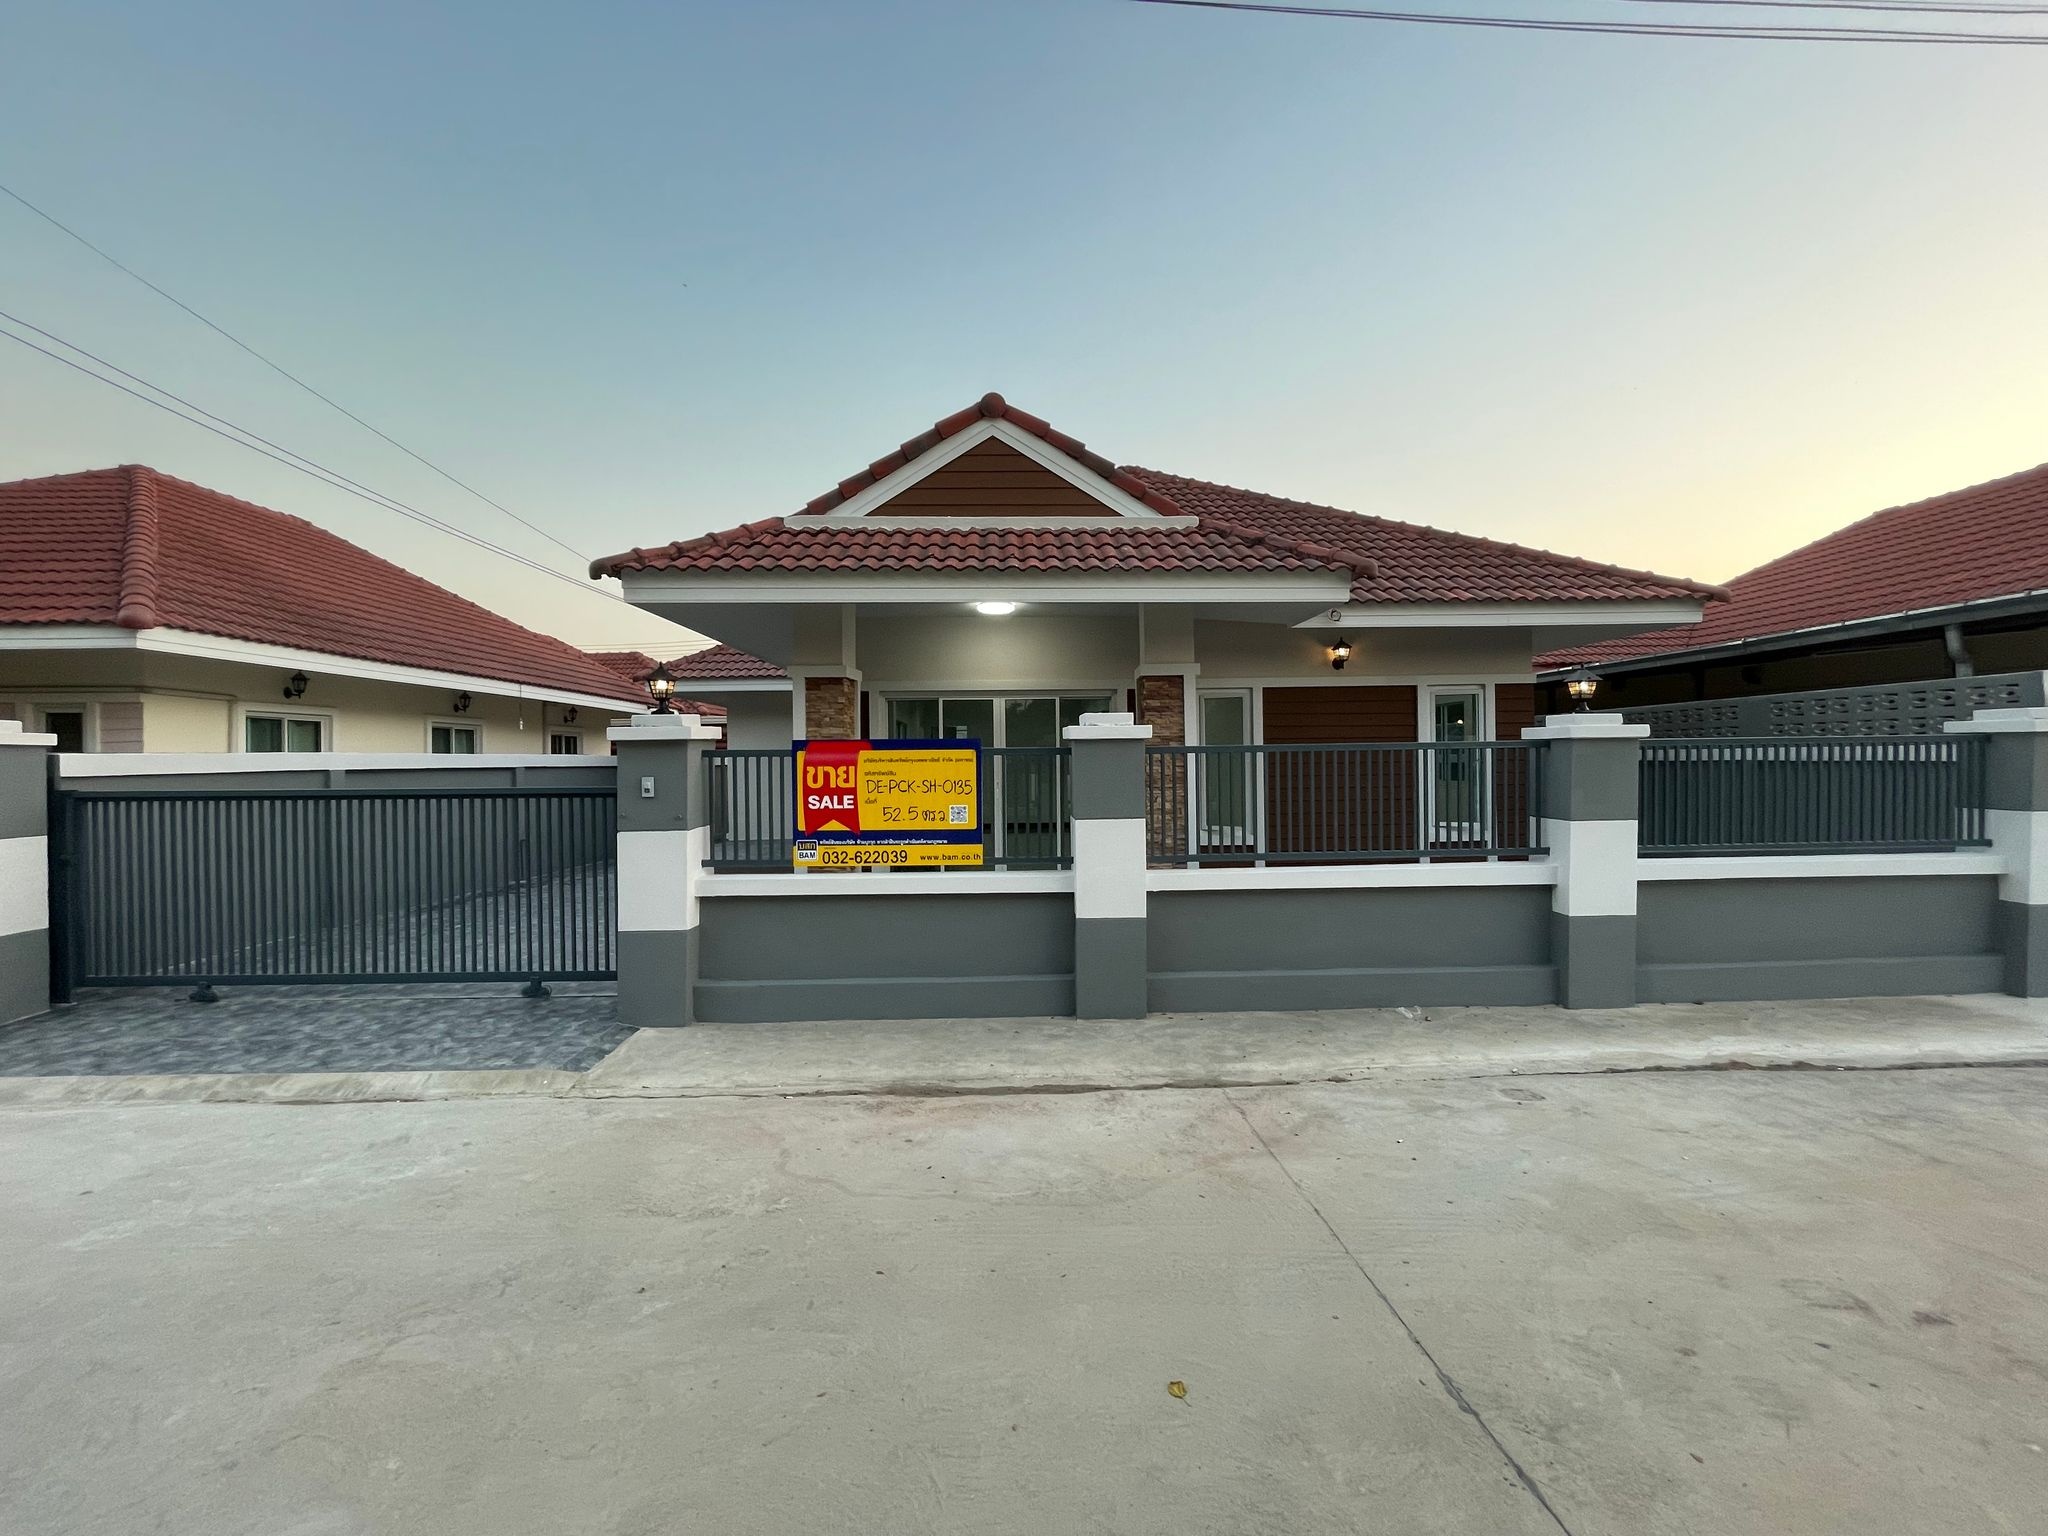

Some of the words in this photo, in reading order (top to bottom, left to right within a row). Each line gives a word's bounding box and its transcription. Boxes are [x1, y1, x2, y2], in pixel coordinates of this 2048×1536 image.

[806, 765, 856, 789] ขาย
[865, 779, 973, 795] DE-PCK-SH-0135
[807, 795, 855, 810] SALE
[799, 851, 816, 859] BAM
[822, 850, 908, 865] 032-622039
[919, 853, 982, 861] www.bam.co.th
